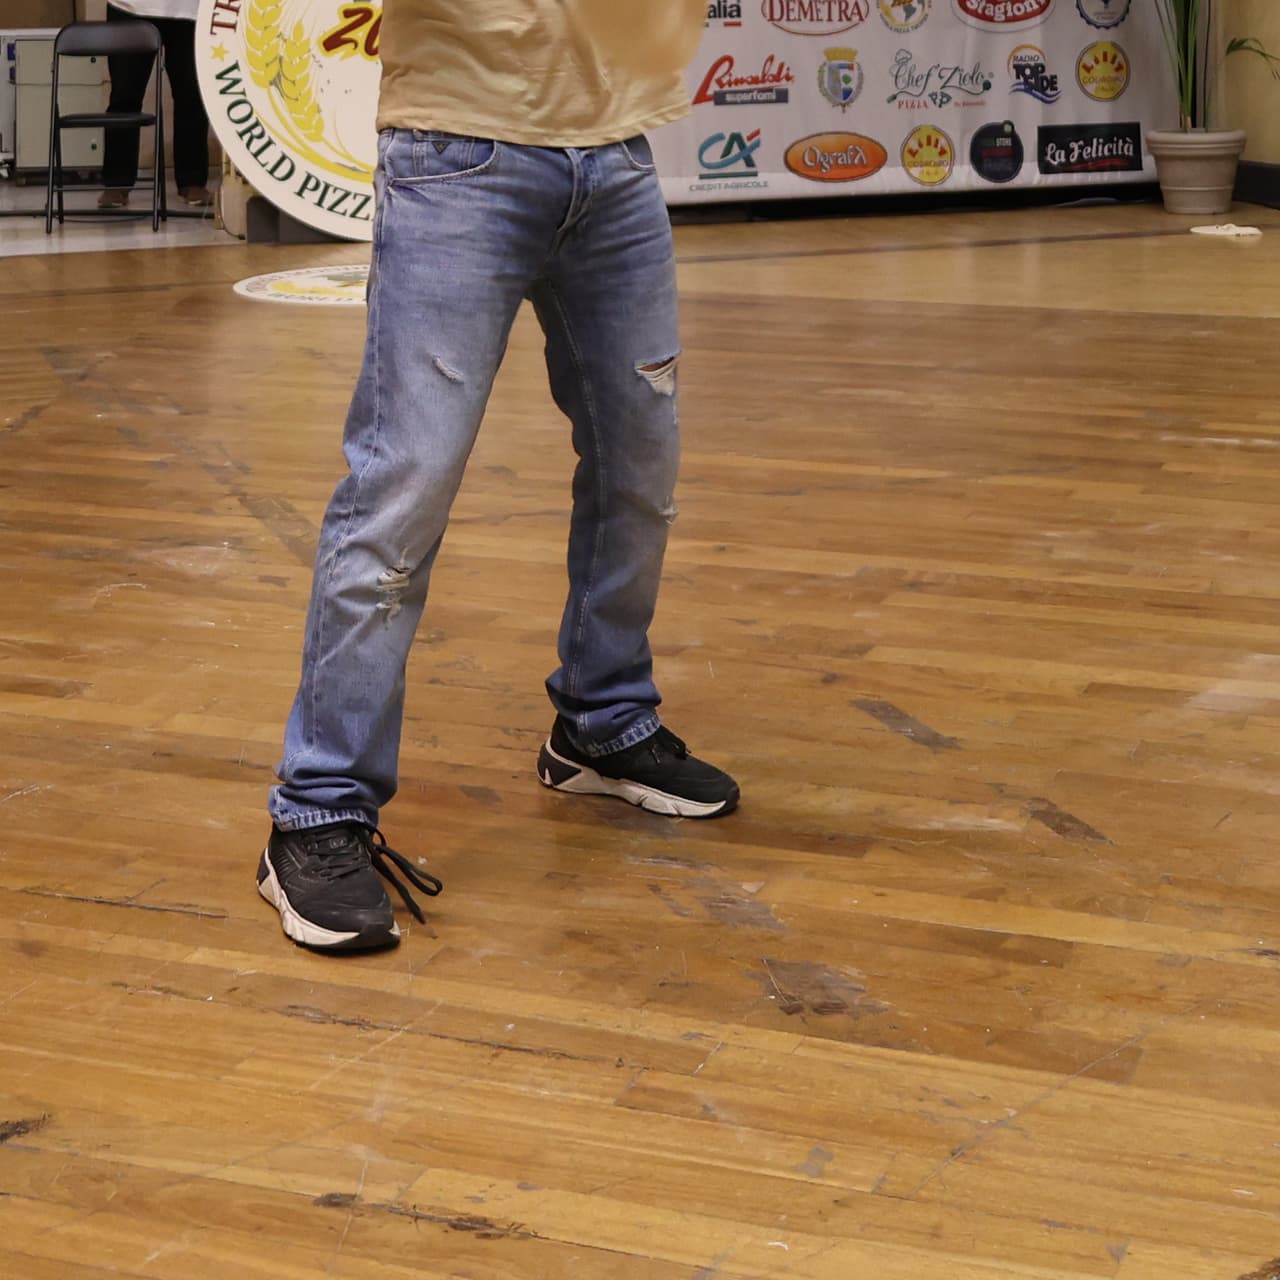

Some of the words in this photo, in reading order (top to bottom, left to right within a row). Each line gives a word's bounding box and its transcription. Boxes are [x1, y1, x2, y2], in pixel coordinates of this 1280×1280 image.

[707, 0, 742, 19] alia
[1012, 63, 1046, 79] TOP
[1013, 54, 1040, 63] RADIO
[691, 54, 794, 106] Rinaldi
[889, 64, 938, 98] Chef
[214, 60, 297, 182] WORLD
[293, 170, 376, 223] PIZZ
[1045, 141, 1066, 166] La
[1069, 136, 1135, 162] Felicità
